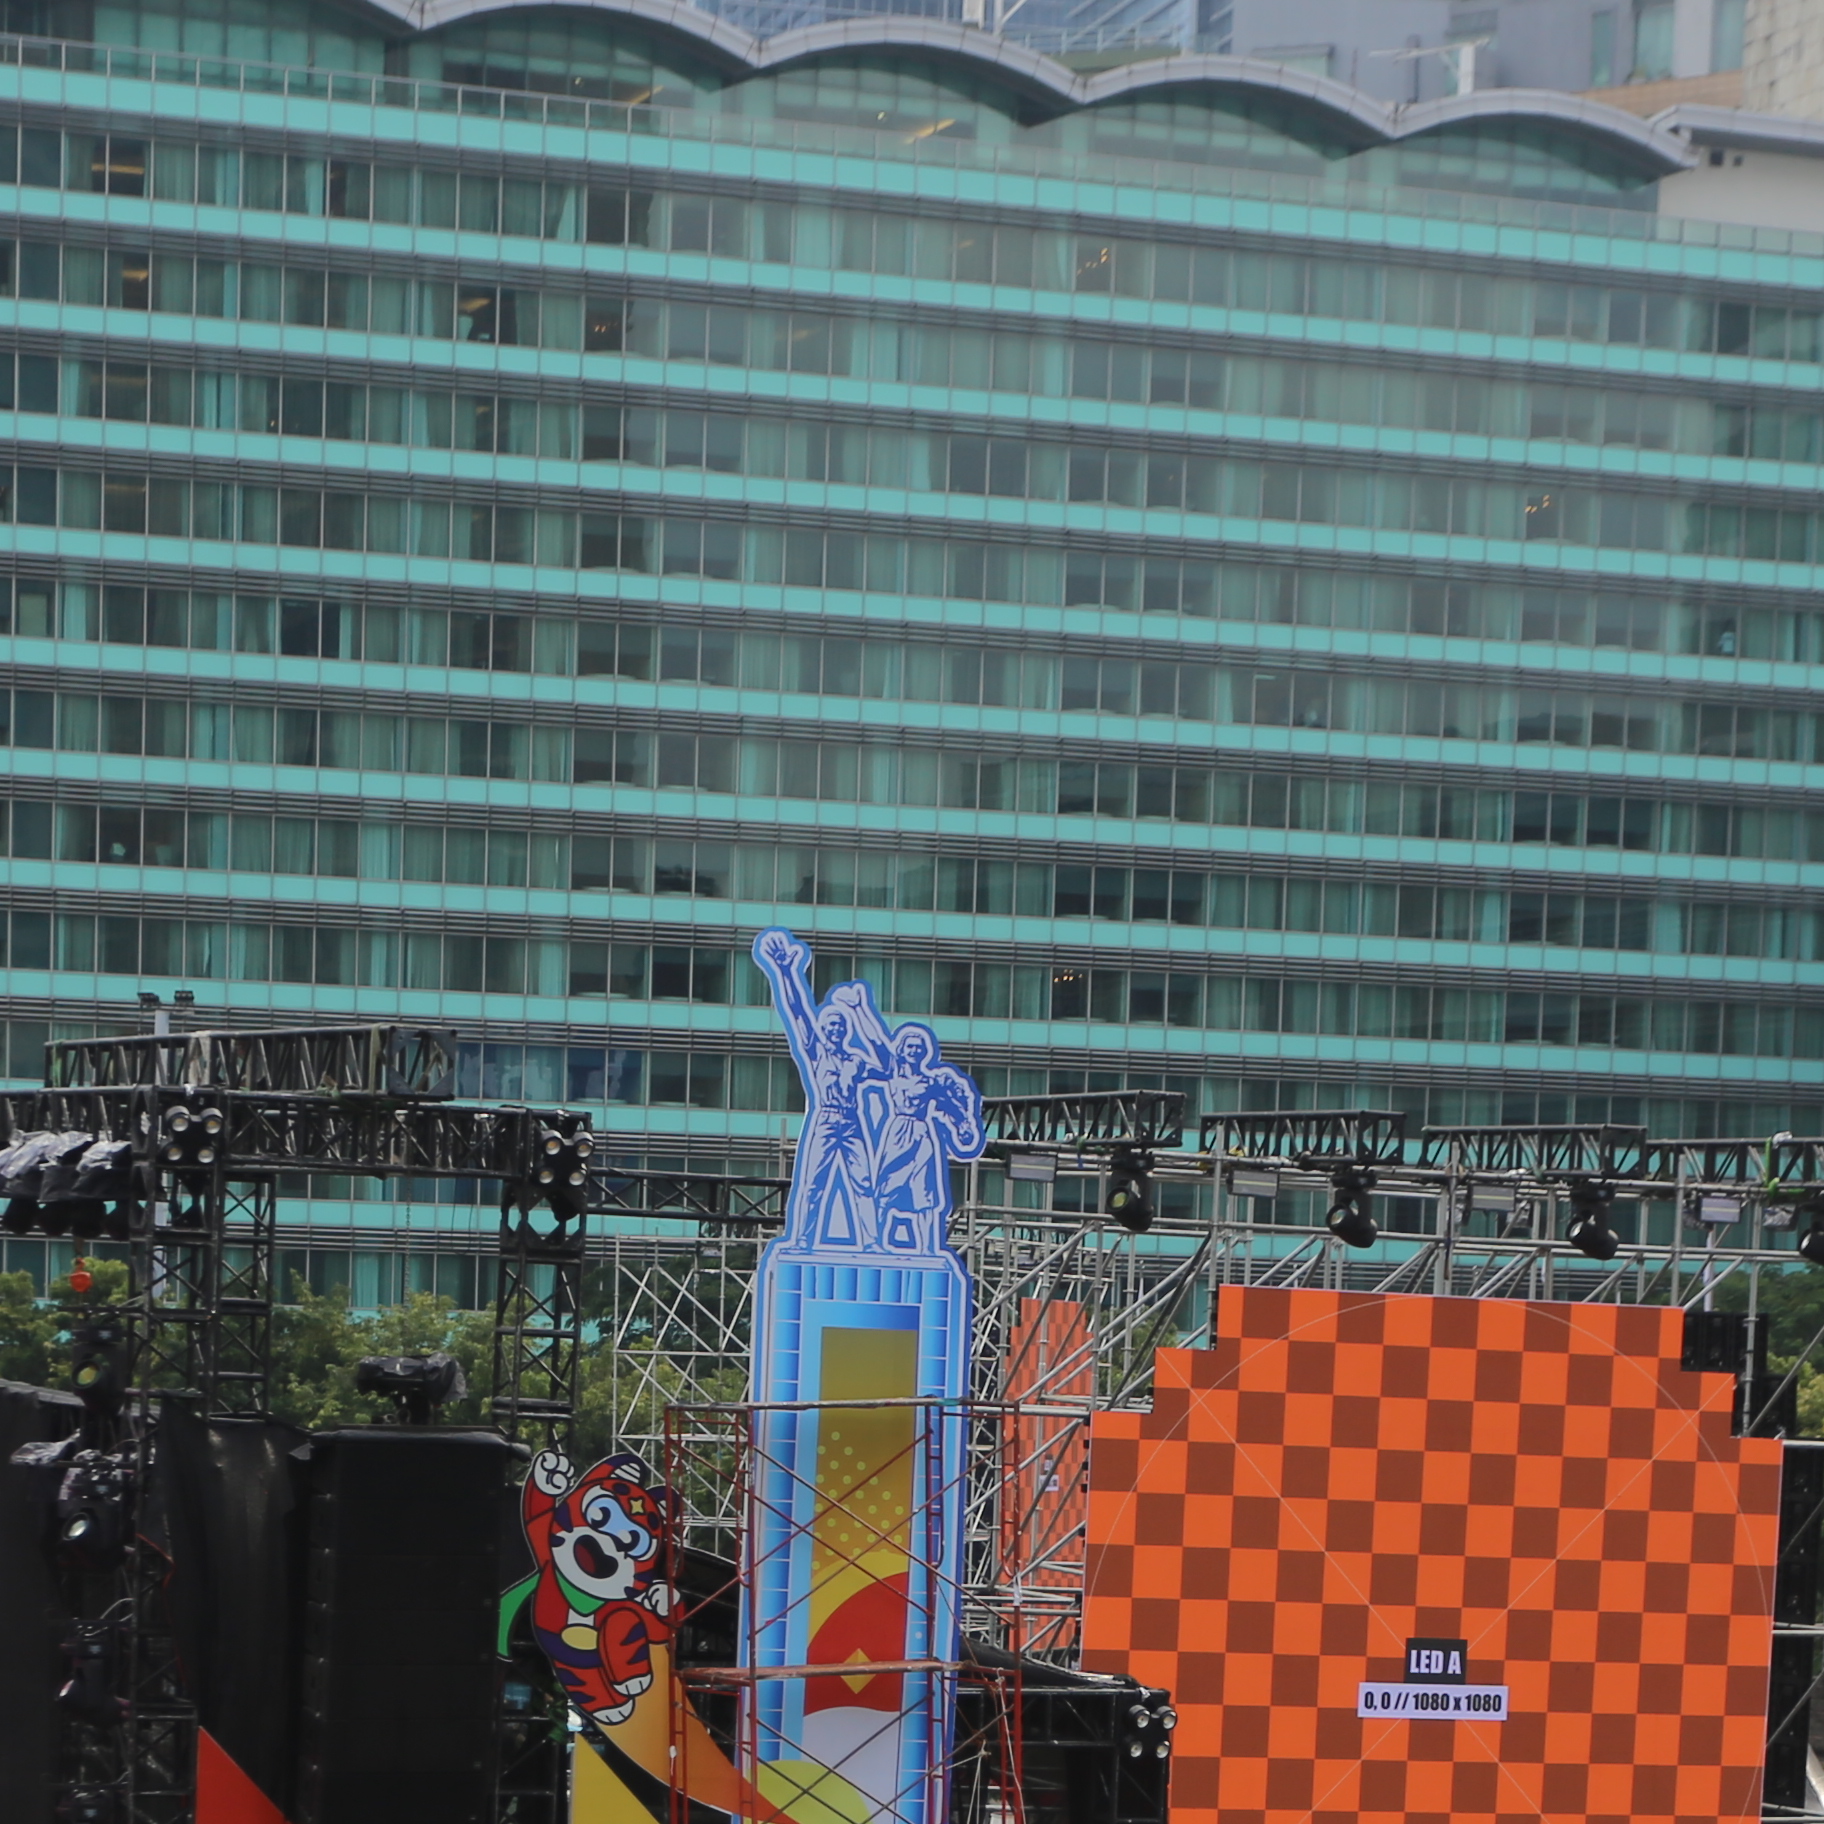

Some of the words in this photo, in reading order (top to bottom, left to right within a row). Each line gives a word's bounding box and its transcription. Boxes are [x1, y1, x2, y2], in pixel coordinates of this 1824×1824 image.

[1409, 1649, 1444, 1675] LED
[1447, 1650, 1462, 1675] A
[1364, 1691, 1377, 1711] 0,
[1380, 1691, 1391, 1710] 0
[1412, 1692, 1450, 1712] 1080
[1453, 1696, 1462, 1711] x
[1465, 1693, 1502, 1713] 1080
